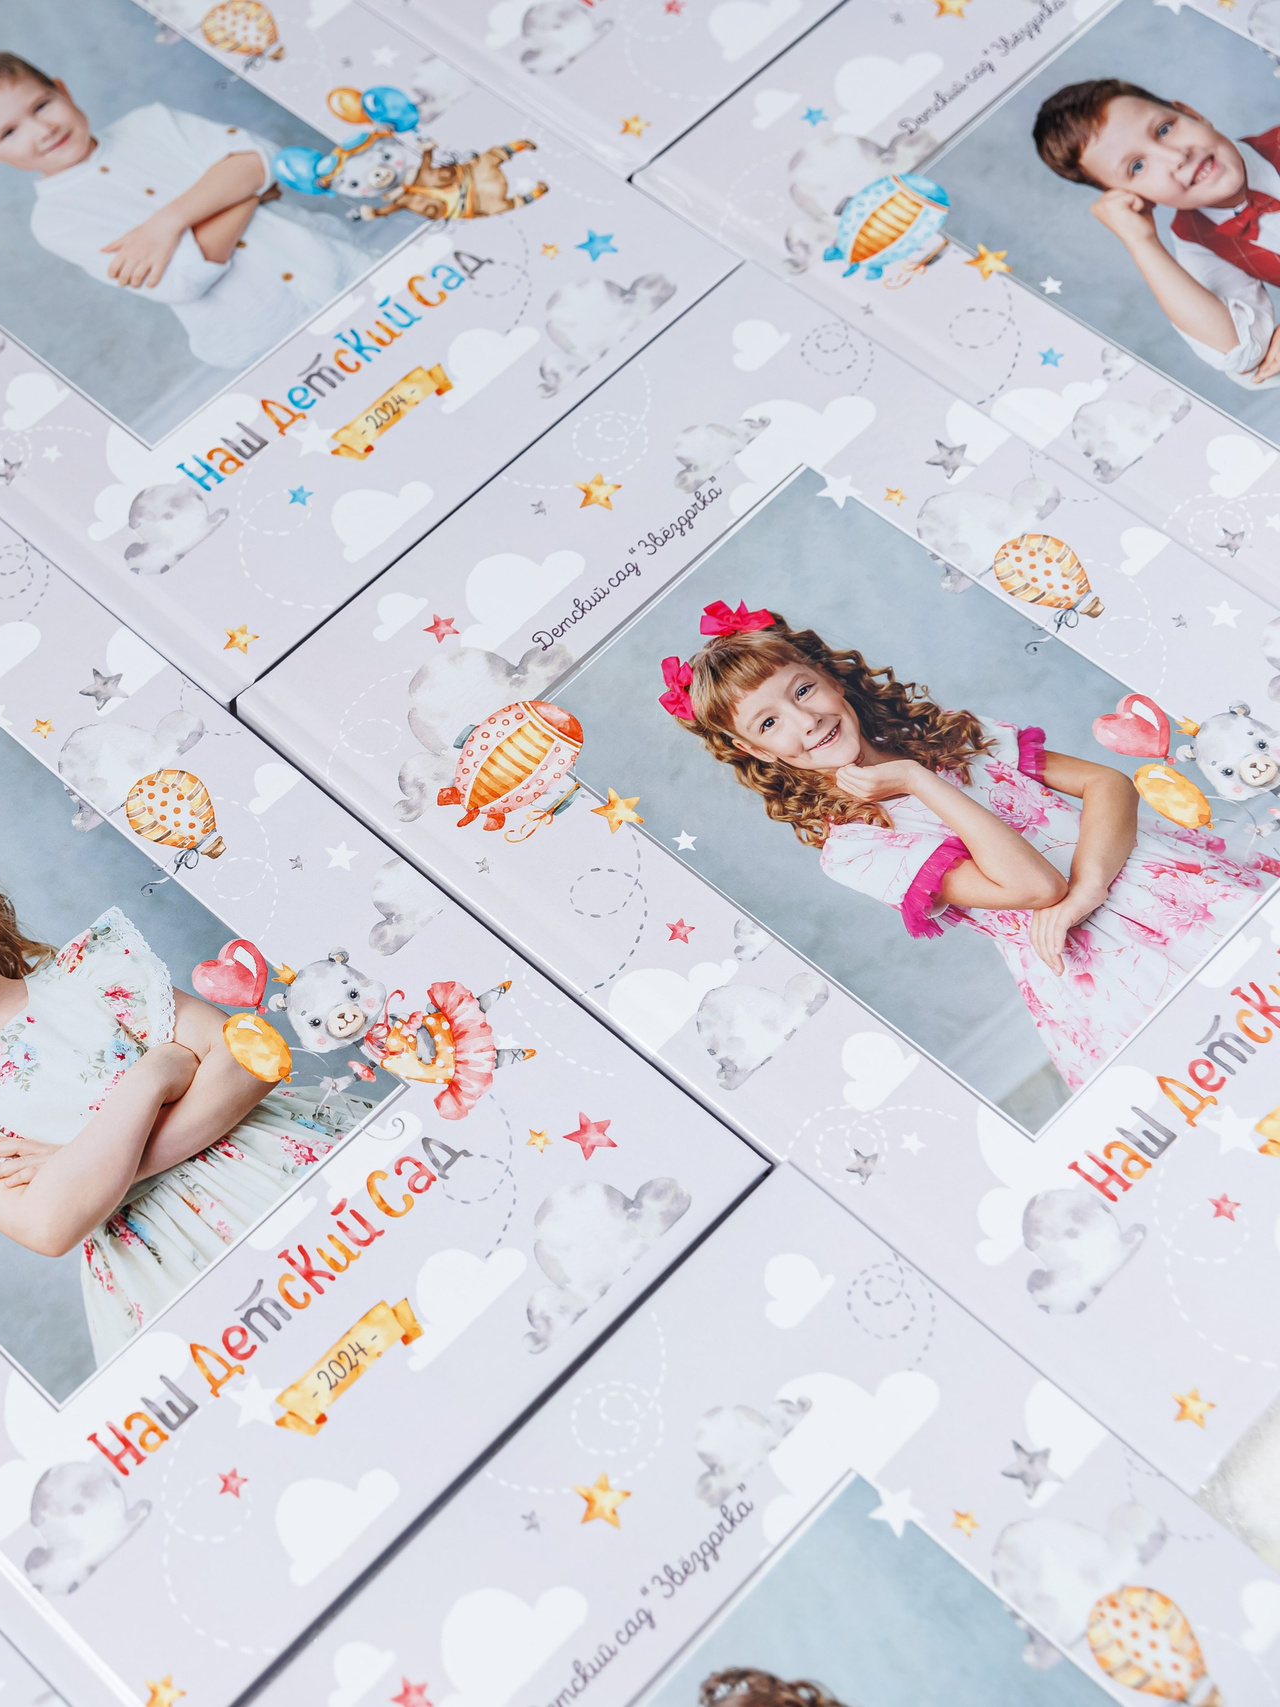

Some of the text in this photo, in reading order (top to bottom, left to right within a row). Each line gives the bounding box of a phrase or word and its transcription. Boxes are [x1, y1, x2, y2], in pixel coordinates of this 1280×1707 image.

[176, 421, 269, 491] Наш
[407, 250, 494, 307] Сад
[532, 586, 610, 651] Детский
[608, 562, 641, 588] сад
[1067, 1106, 1177, 1202] Наш
[87, 1375, 198, 1476] Наш
[366, 1137, 473, 1218] Сад
[615, 1607, 656, 1645] сад
